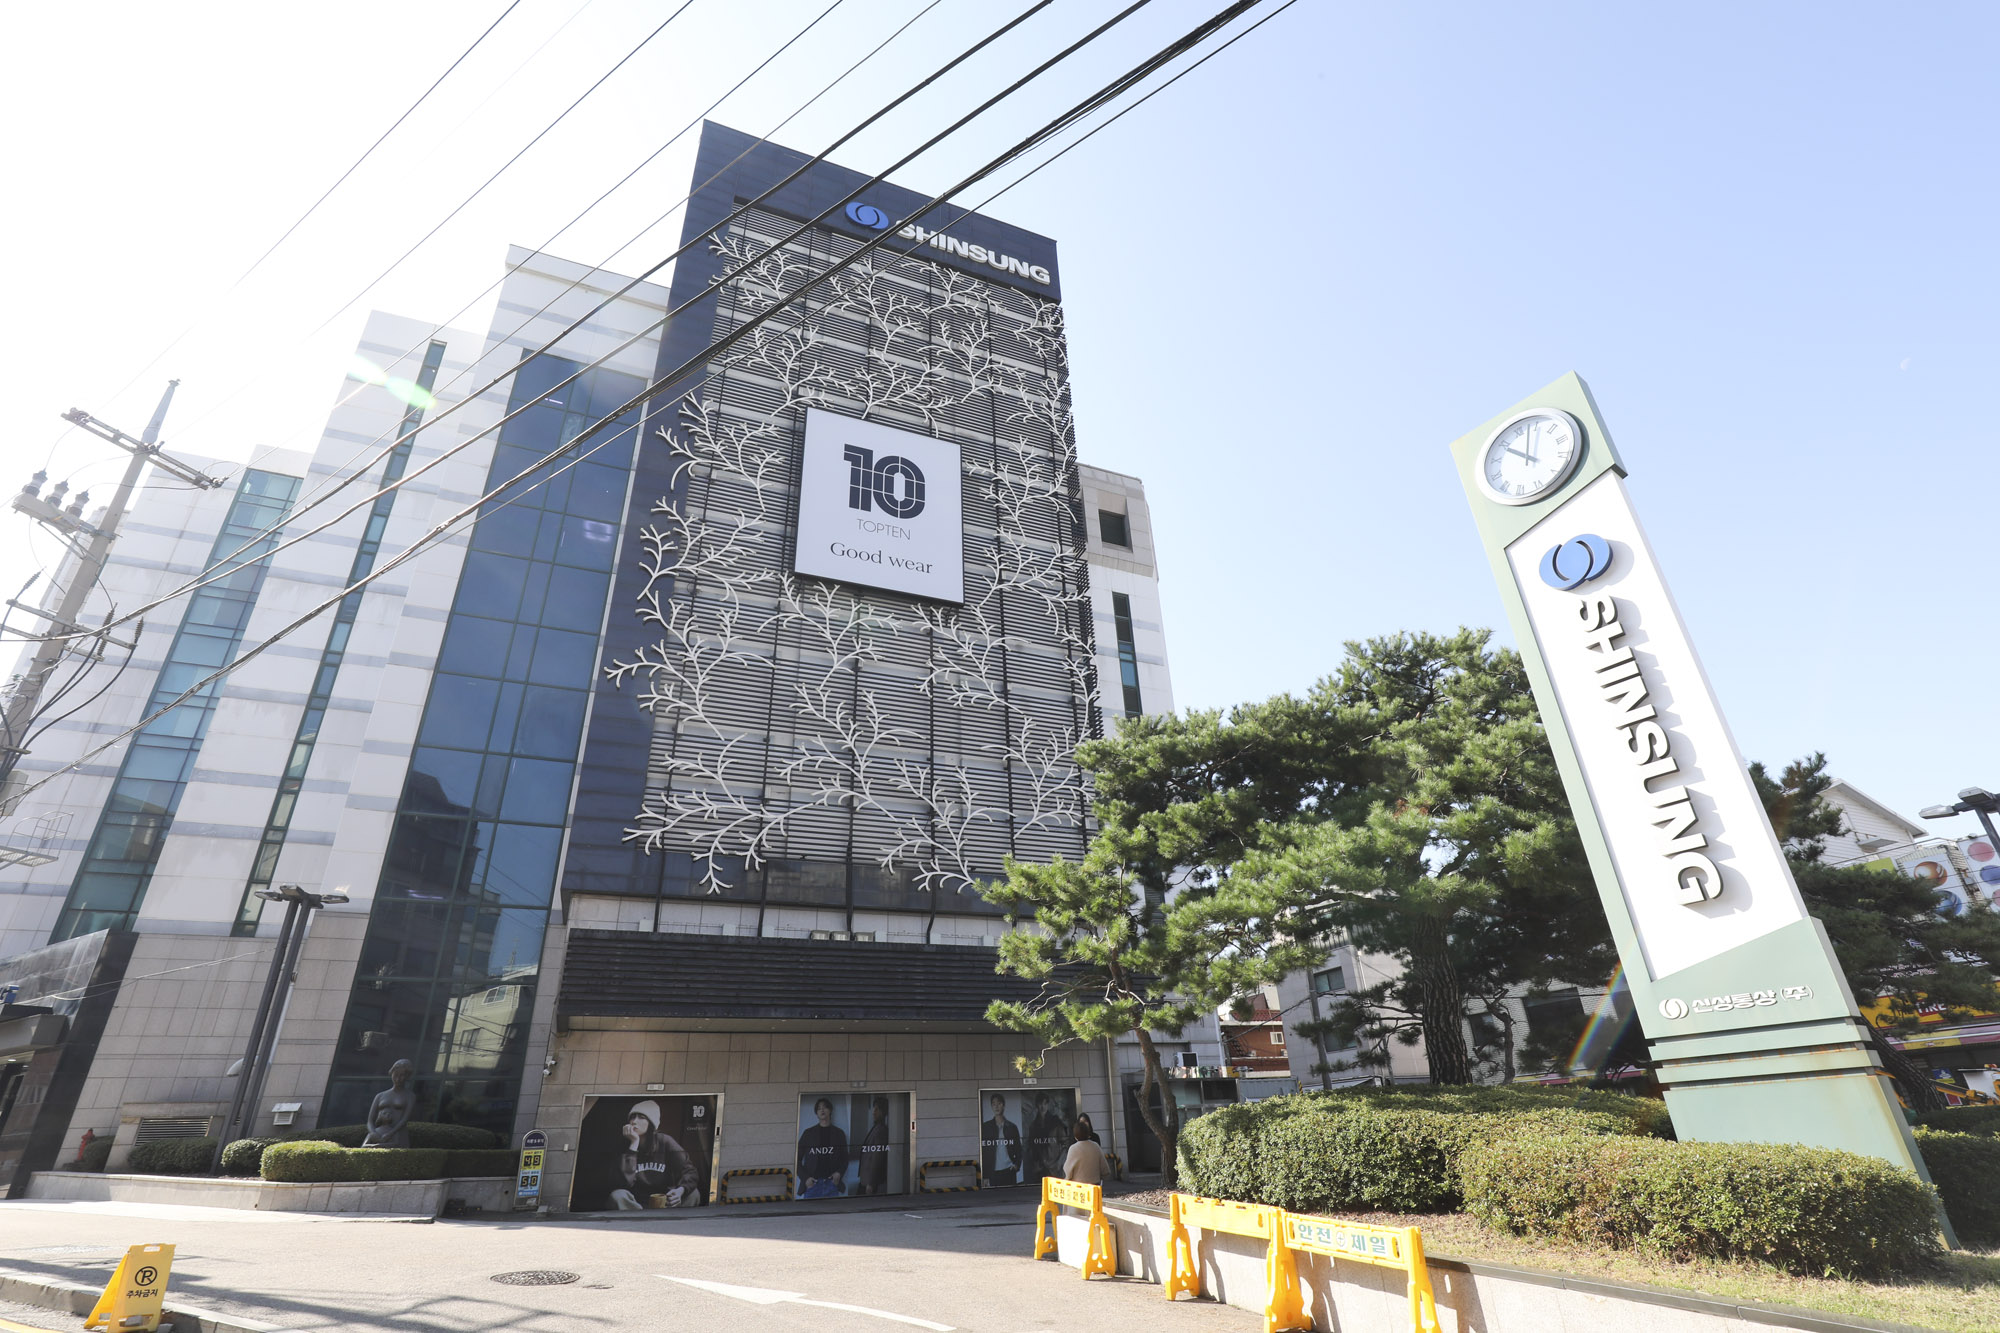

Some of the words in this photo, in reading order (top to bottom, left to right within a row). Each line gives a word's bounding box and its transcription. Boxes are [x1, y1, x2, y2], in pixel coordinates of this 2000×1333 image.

[896, 219, 1051, 286] SHINSUNG
[843, 443, 926, 520] 10
[857, 518, 911, 541] TOPTEN
[830, 542, 882, 564] Good
[888, 555, 933, 574] wear
[1579, 594, 1725, 908] SHINSUNG
[1692, 988, 1778, 1014] 신성통상
[692, 1105, 705, 1118] 10
[808, 1146, 834, 1155] ANDZ
[861, 1145, 891, 1153] ZIOZIA
[1298, 1223, 1332, 1245] 안전
[1351, 1234, 1387, 1254] 제일
[126, 1288, 159, 1299] 주차금지
